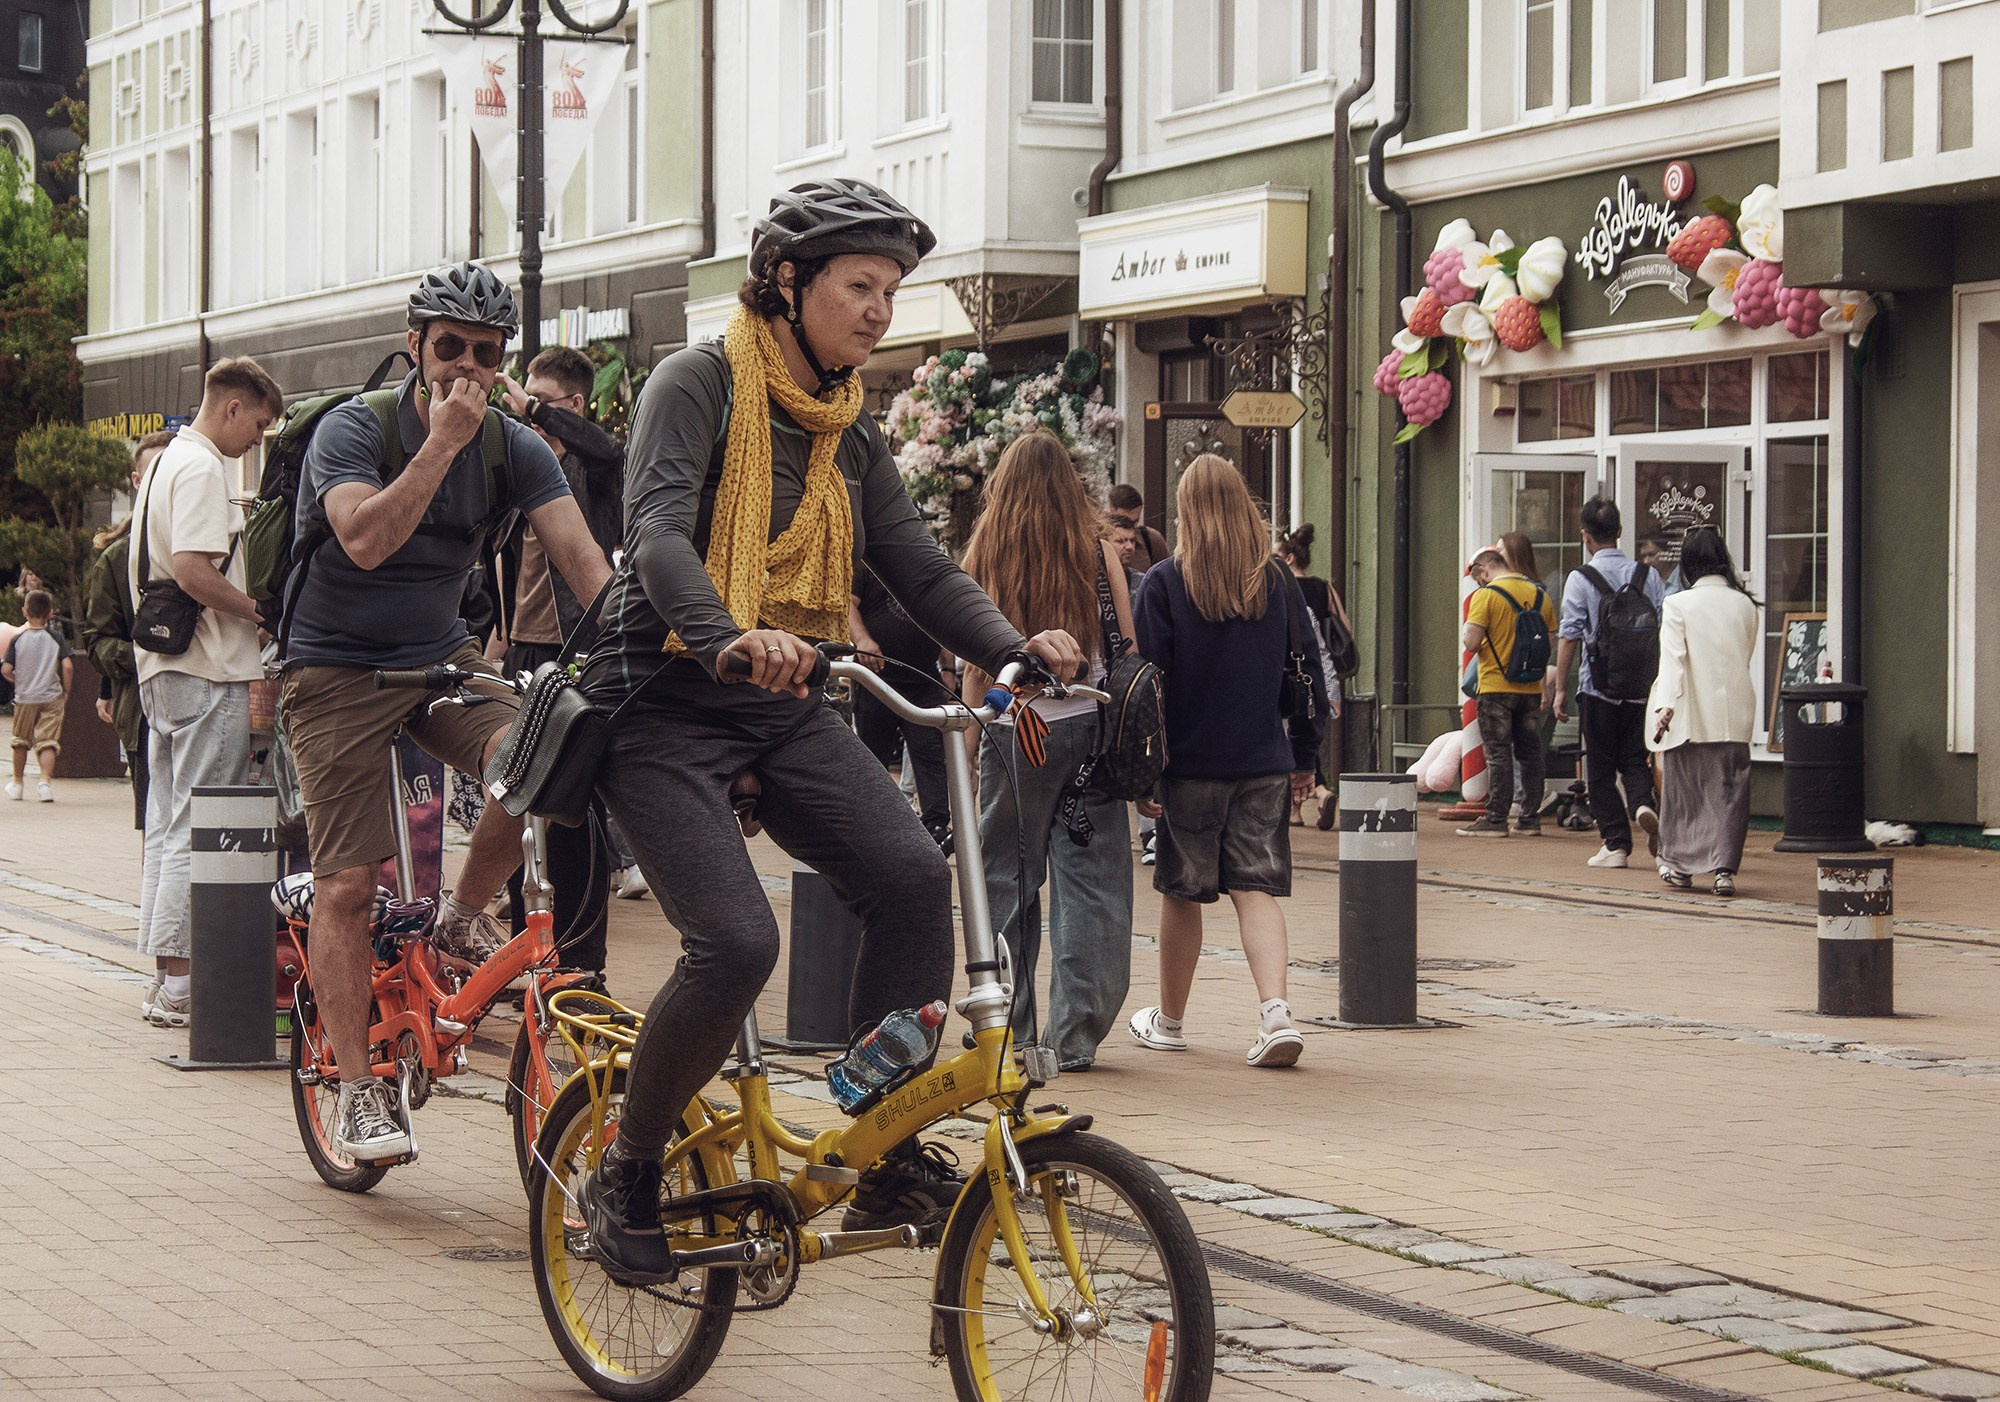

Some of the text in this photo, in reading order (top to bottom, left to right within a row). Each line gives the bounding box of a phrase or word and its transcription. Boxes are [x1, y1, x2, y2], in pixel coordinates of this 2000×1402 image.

[475, 106, 507, 117] ПОБЕДА!
[552, 109, 588, 119] ПОБЕДА!
[1111, 250, 1231, 281] Amber EMPIRE
[1622, 263, 1673, 282] МАНУФАКТУРА
[584, 308, 626, 340] ЛАВКА
[1237, 401, 1292, 415] Amber
[128, 412, 164, 440] МИР
[1096, 570, 1116, 621] GUESS
[875, 1076, 943, 1131] SHULZ
